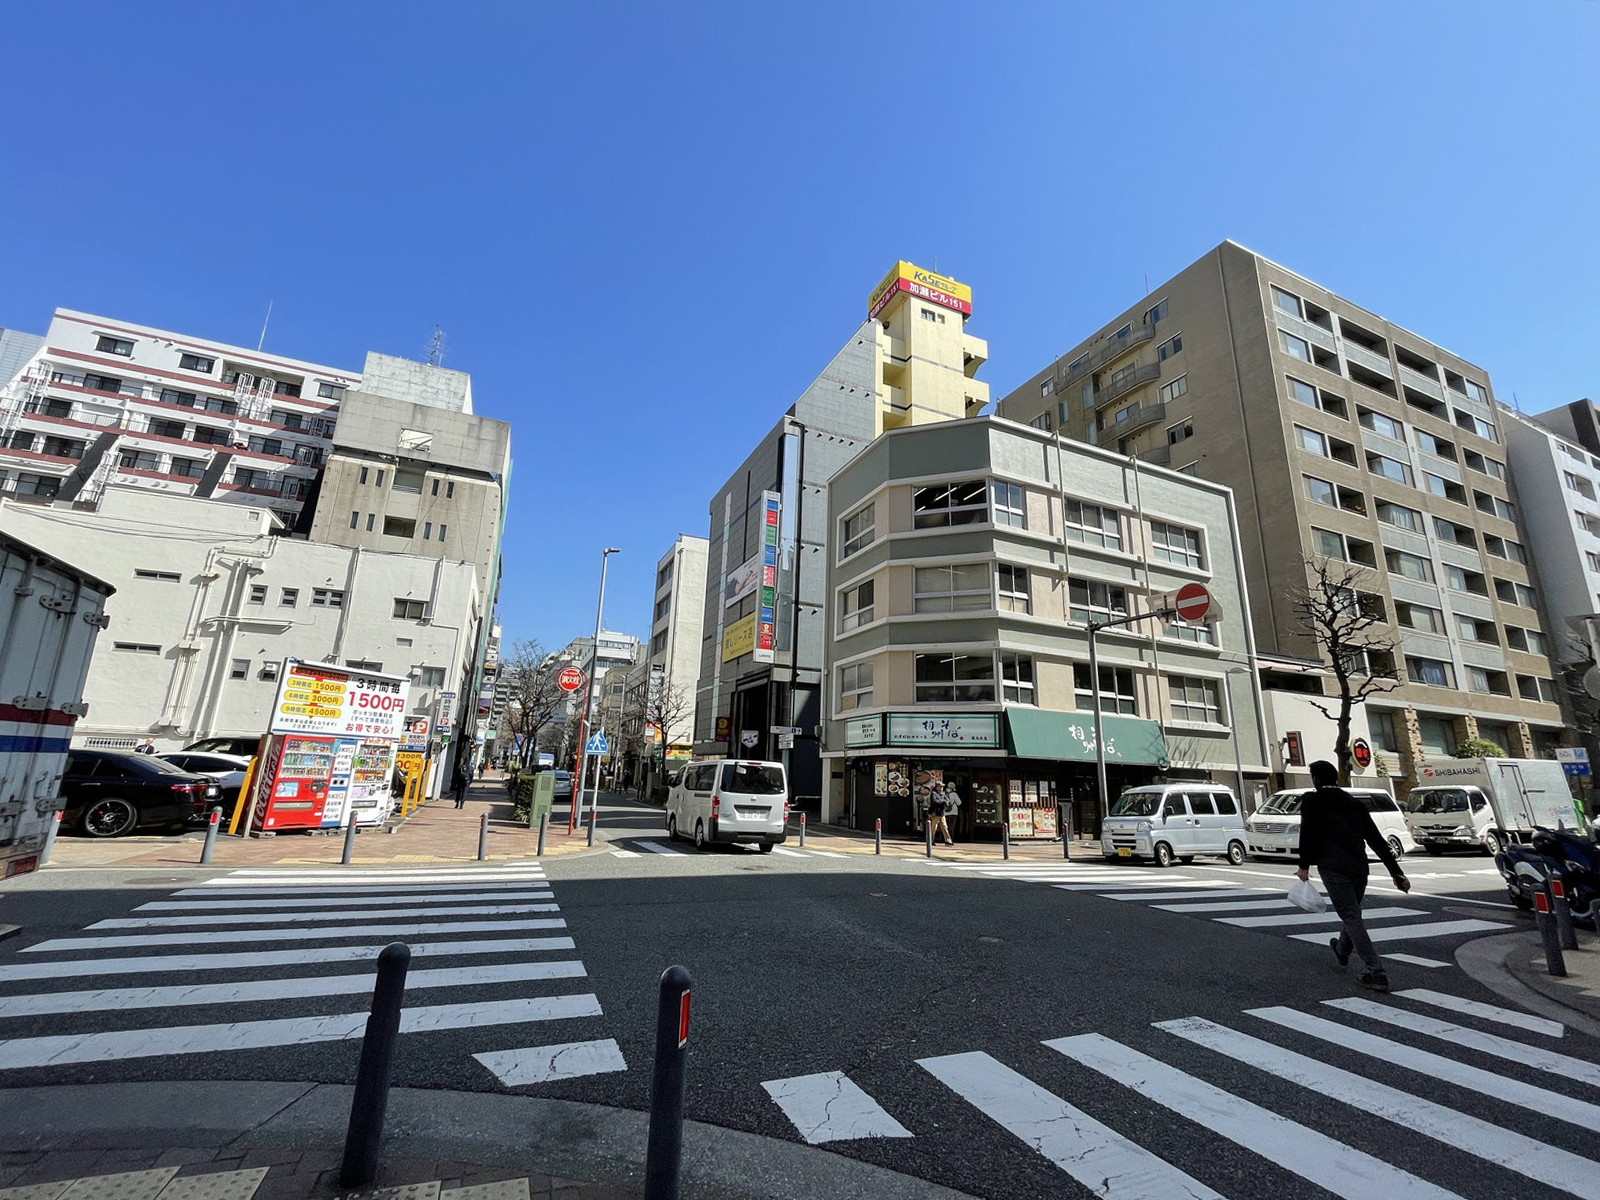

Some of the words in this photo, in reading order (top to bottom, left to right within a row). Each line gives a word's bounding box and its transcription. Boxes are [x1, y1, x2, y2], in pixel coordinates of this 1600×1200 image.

[315, 682, 342, 692] 1500円
[357, 678, 401, 694] 3時間毎
[311, 694, 339, 705] 3000円
[349, 691, 405, 713] 1500円
[308, 707, 337, 718] 4500円
[345, 722, 395, 735] お得で安心!
